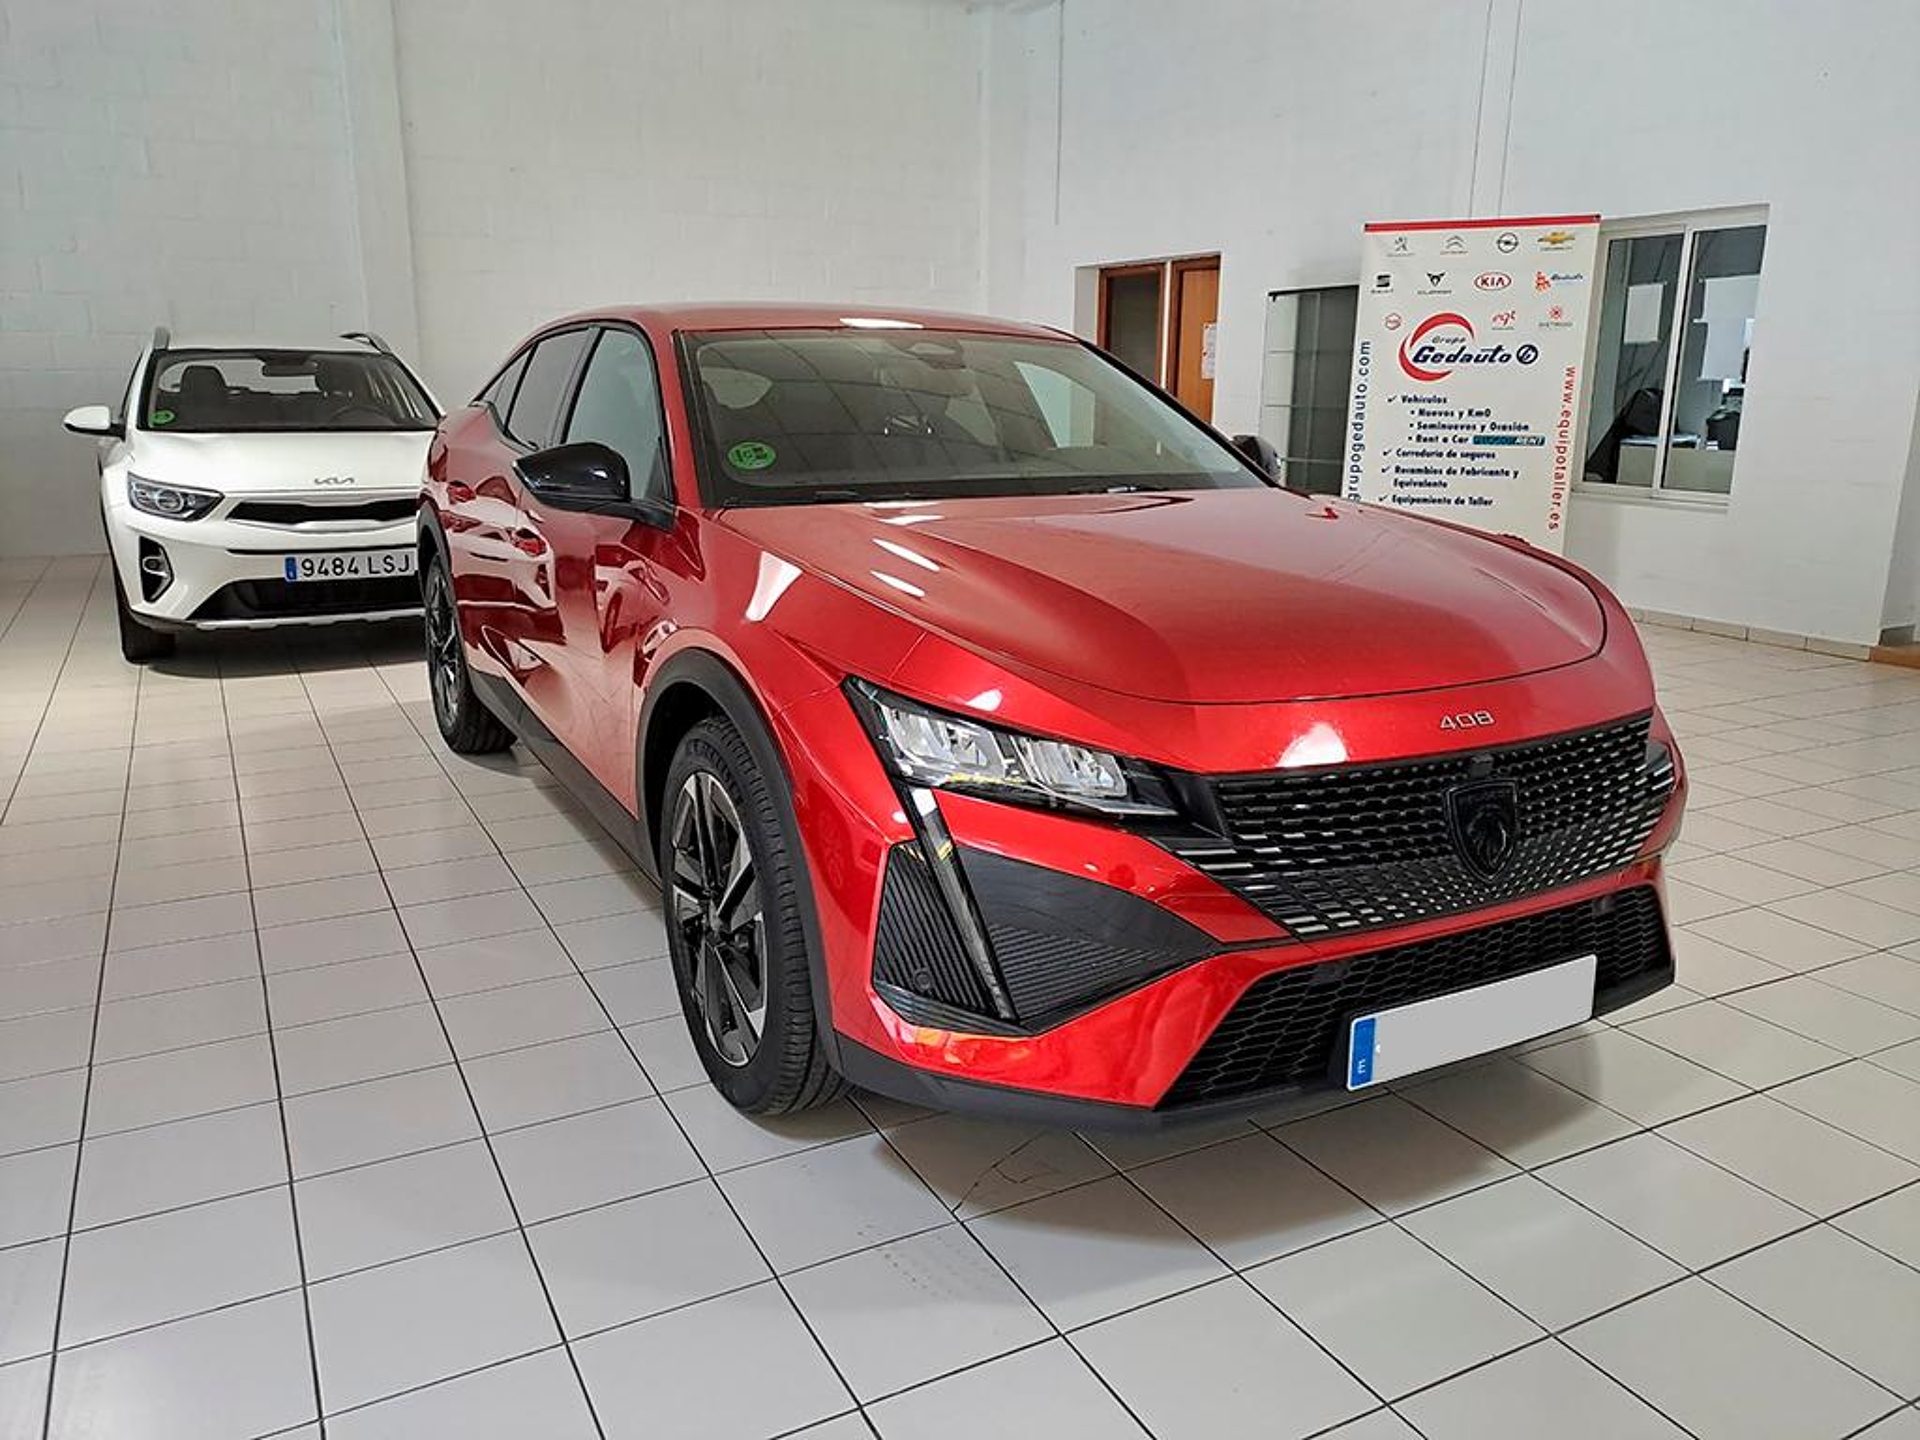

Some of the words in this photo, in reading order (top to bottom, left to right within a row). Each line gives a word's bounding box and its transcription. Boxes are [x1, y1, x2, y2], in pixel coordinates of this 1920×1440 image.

[1412, 345, 1511, 364] Gedauto
[1416, 434, 1439, 443] Rent
[1452, 434, 1469, 443] Car
[1446, 449, 1457, 458] de
[1446, 466, 1457, 475] de
[1454, 496, 1465, 505] de
[301, 557, 359, 577] 9484
[367, 554, 410, 575] LSJ
[1440, 710, 1495, 729] 408
